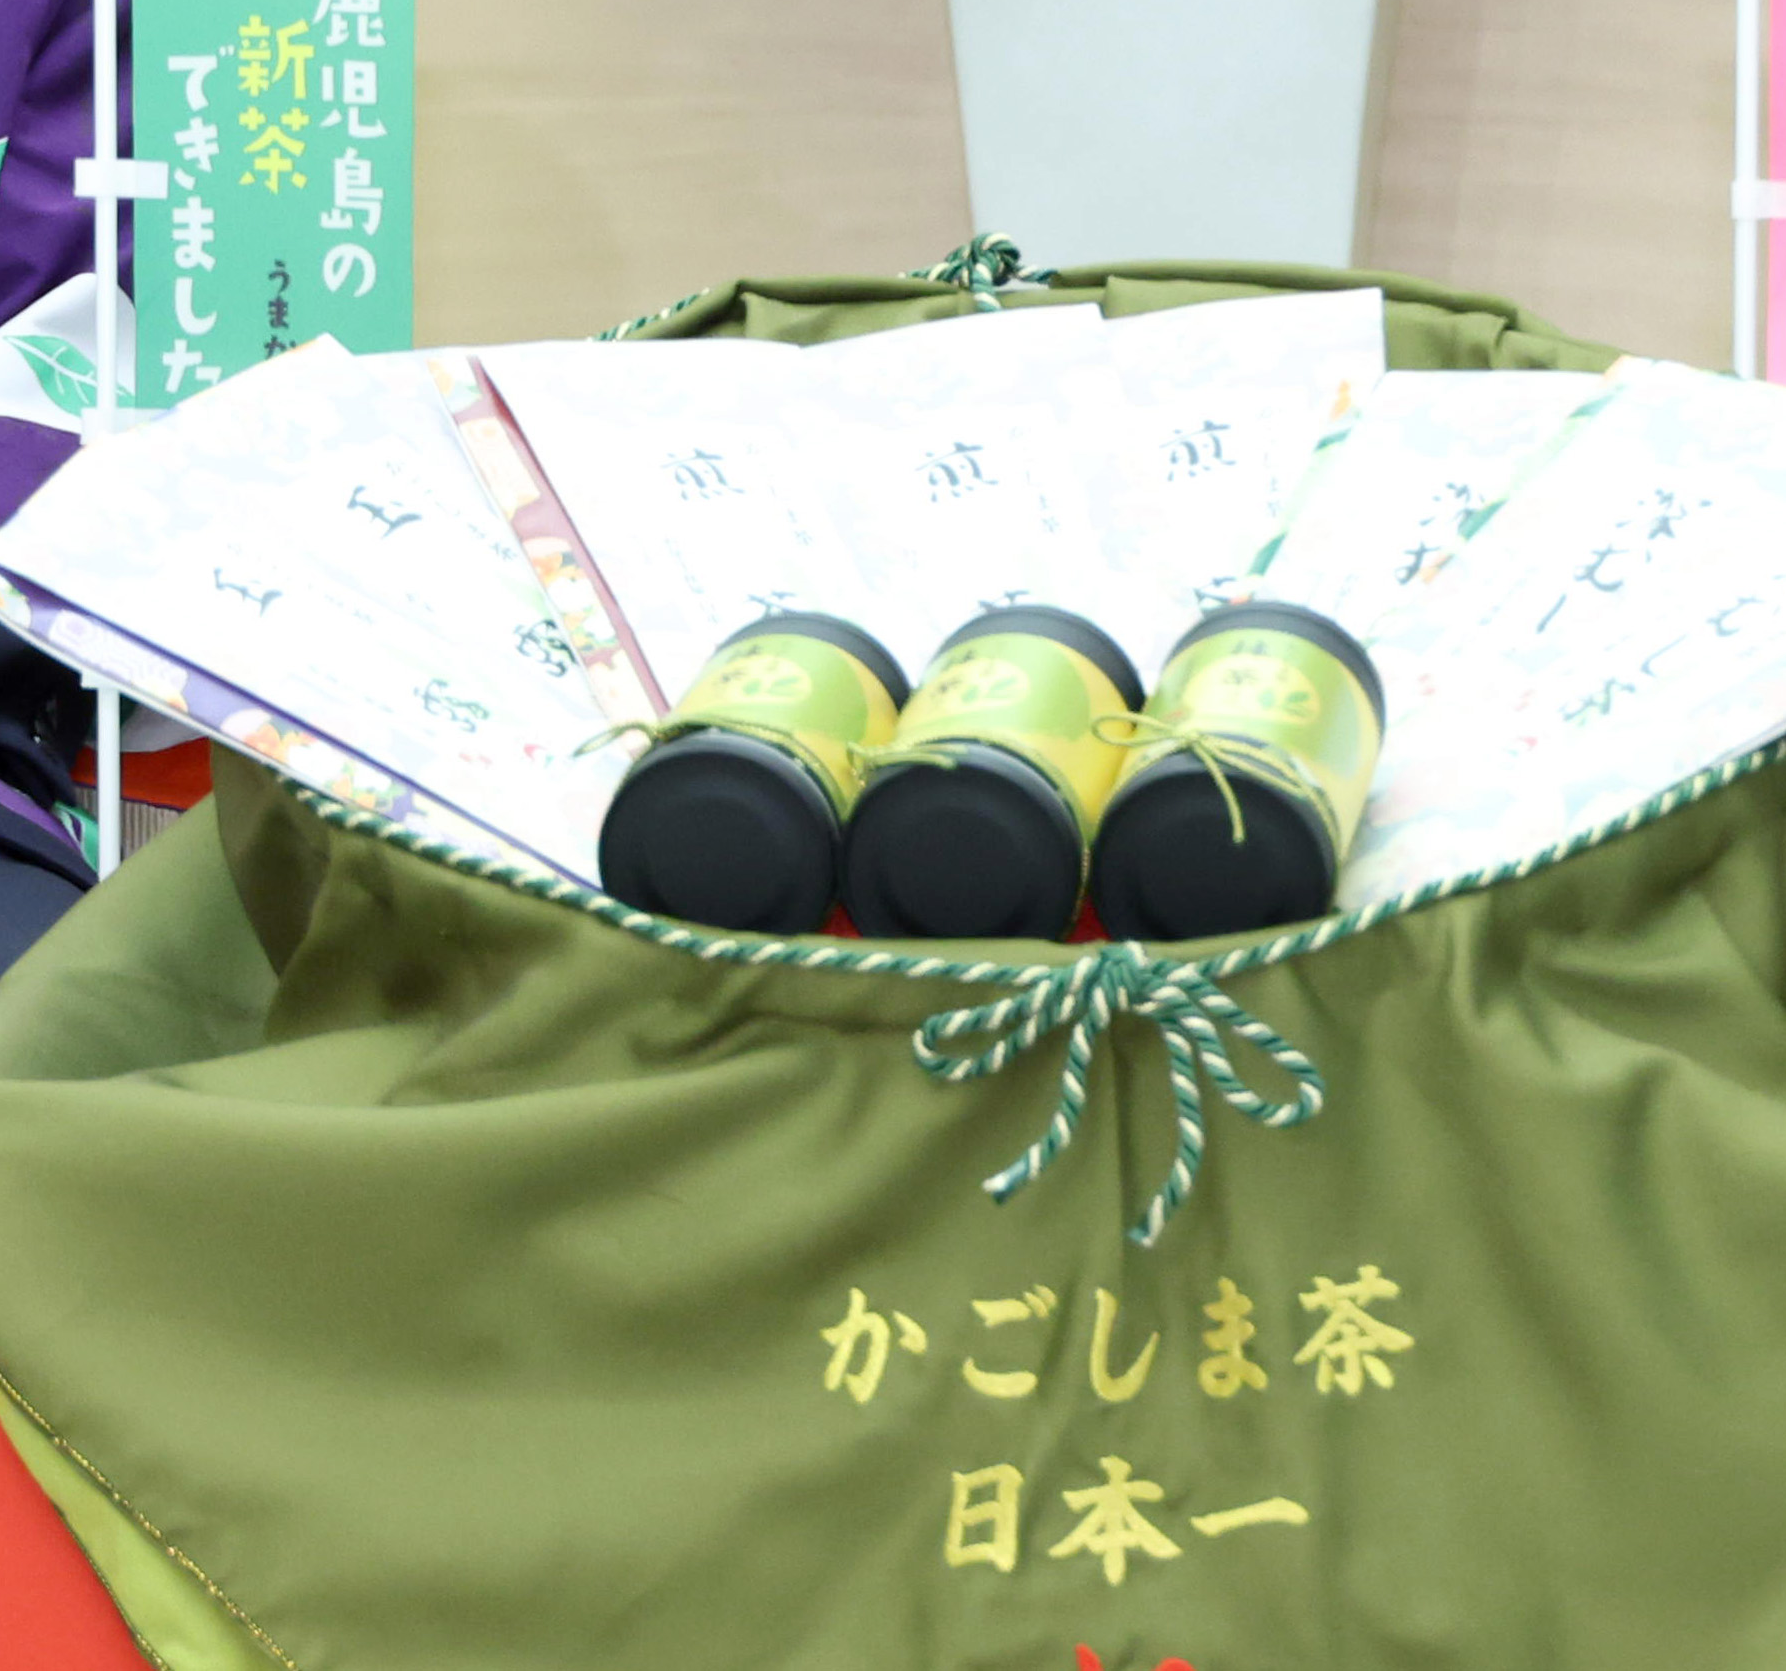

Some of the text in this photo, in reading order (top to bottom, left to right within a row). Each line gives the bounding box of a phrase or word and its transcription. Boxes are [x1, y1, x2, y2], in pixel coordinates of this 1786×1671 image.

[237, 14, 315, 194] 新茶
[161, 42, 236, 393] できました
[818, 1264, 1415, 1404] かごしま茶
[945, 1455, 1310, 1587] 日本一
